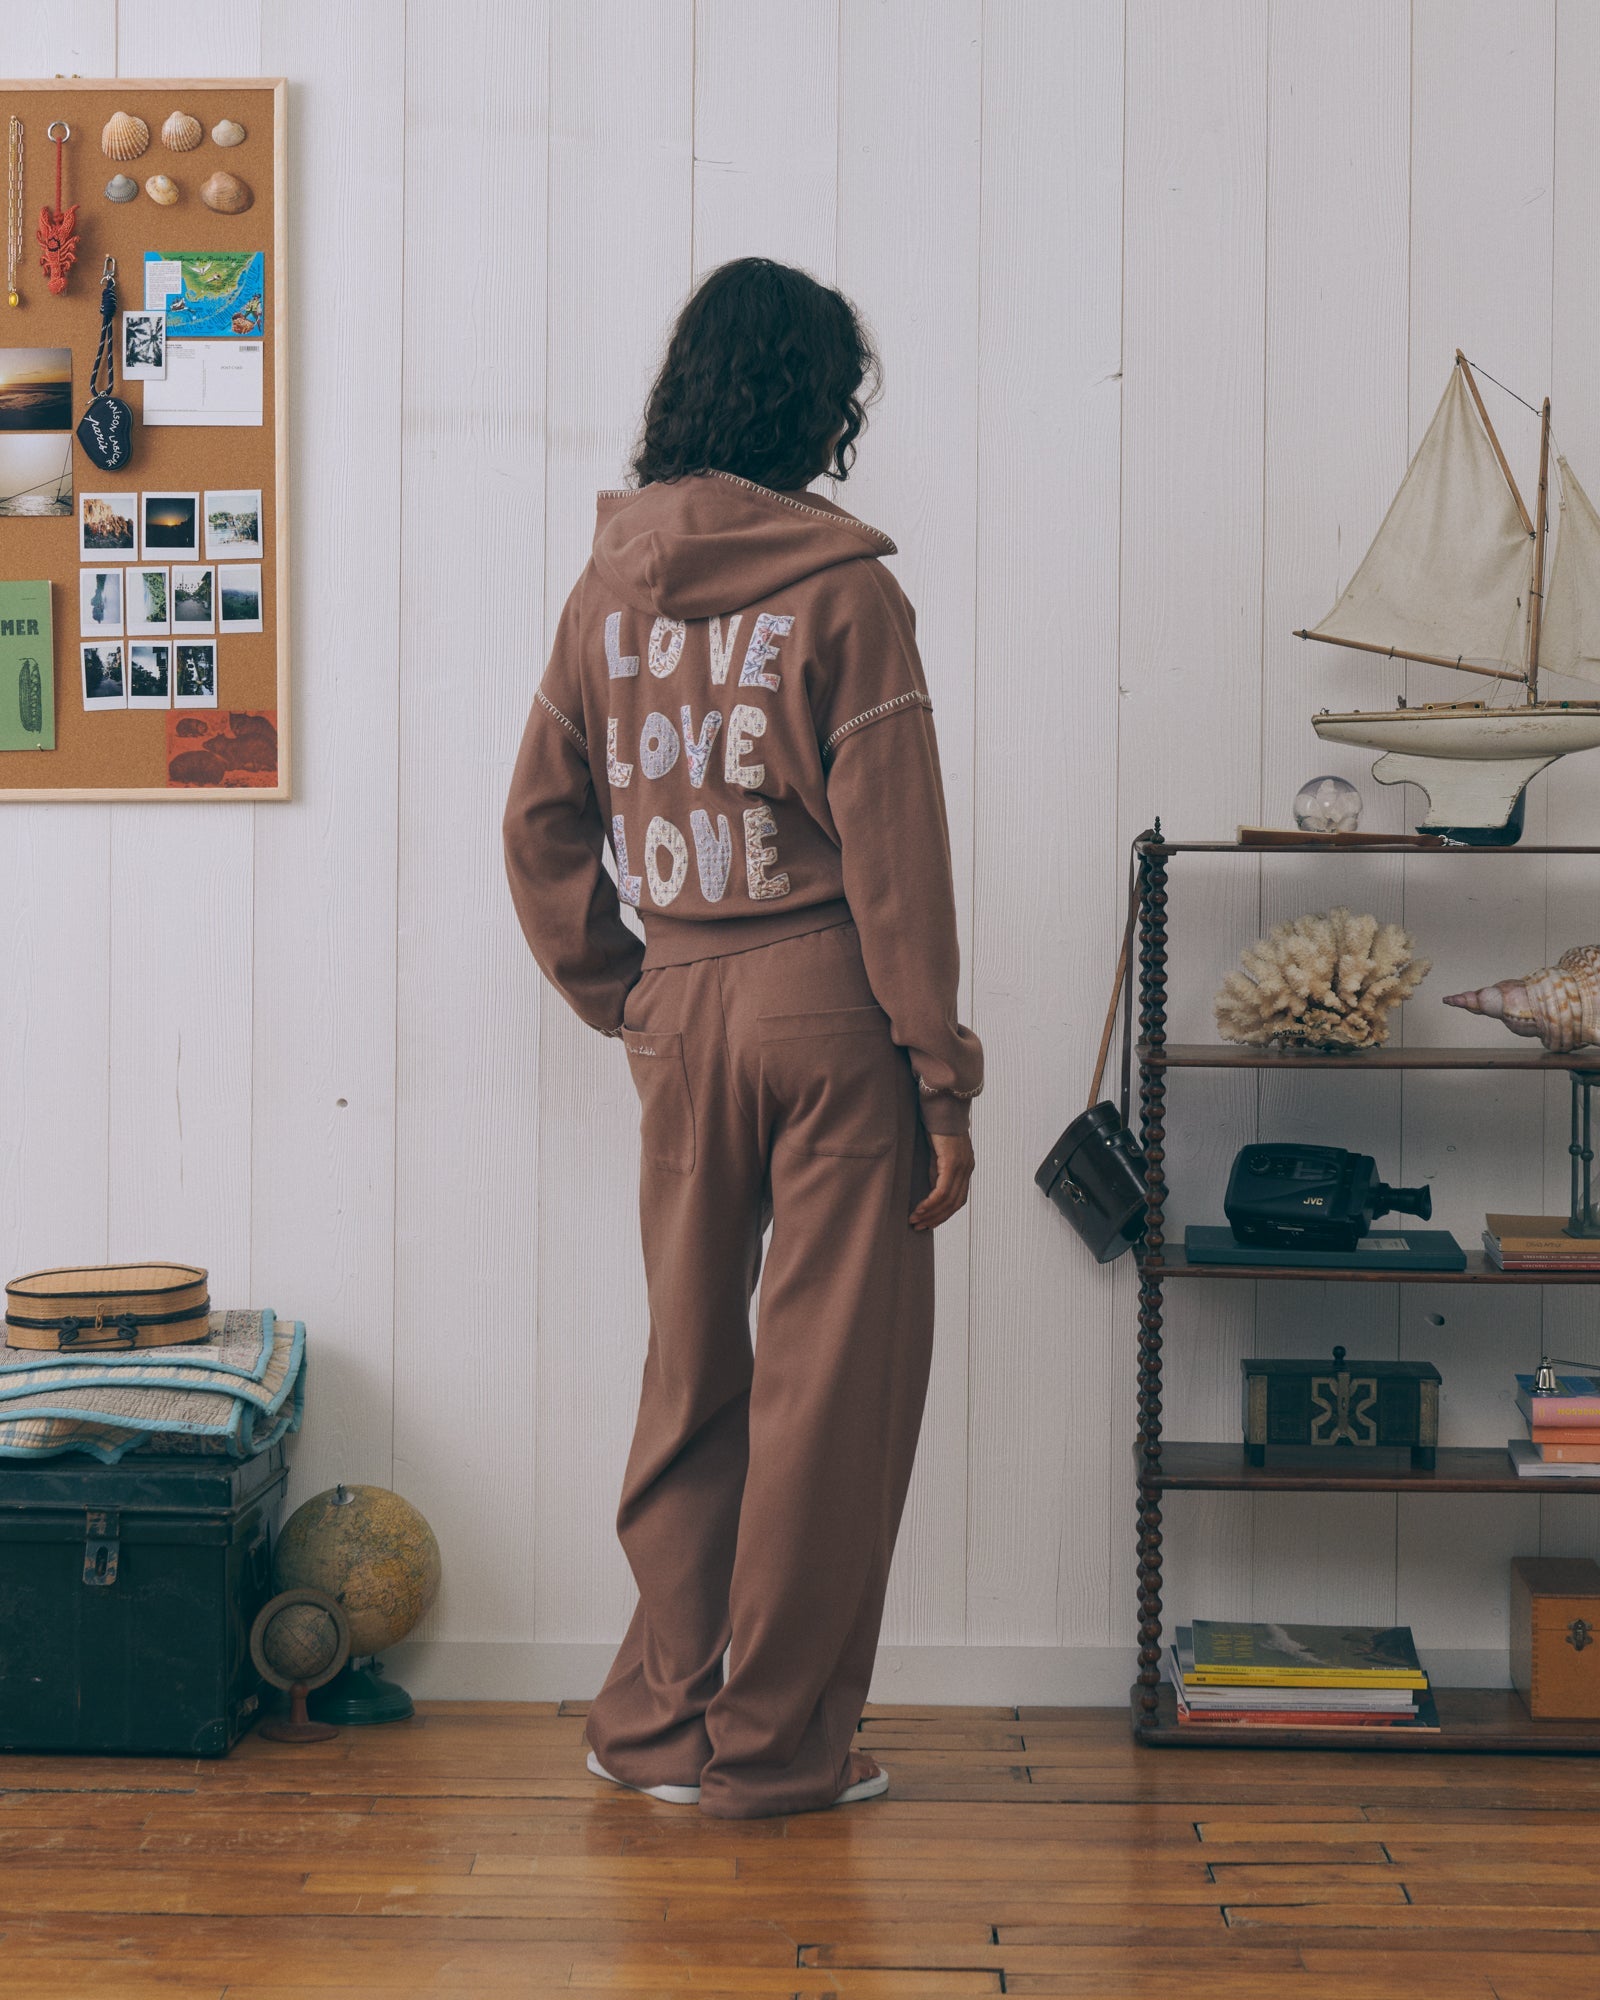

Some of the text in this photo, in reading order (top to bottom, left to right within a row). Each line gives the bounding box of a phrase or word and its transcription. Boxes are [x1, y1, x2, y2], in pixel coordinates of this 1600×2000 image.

[84, 415, 108, 455] paris
[105, 399, 122, 467] MAISON LABICHE
[604, 610, 796, 694] LOVE
[606, 704, 768, 789] LOVE
[611, 805, 792, 907] LOVE
[1303, 1197, 1324, 1206] JVC
